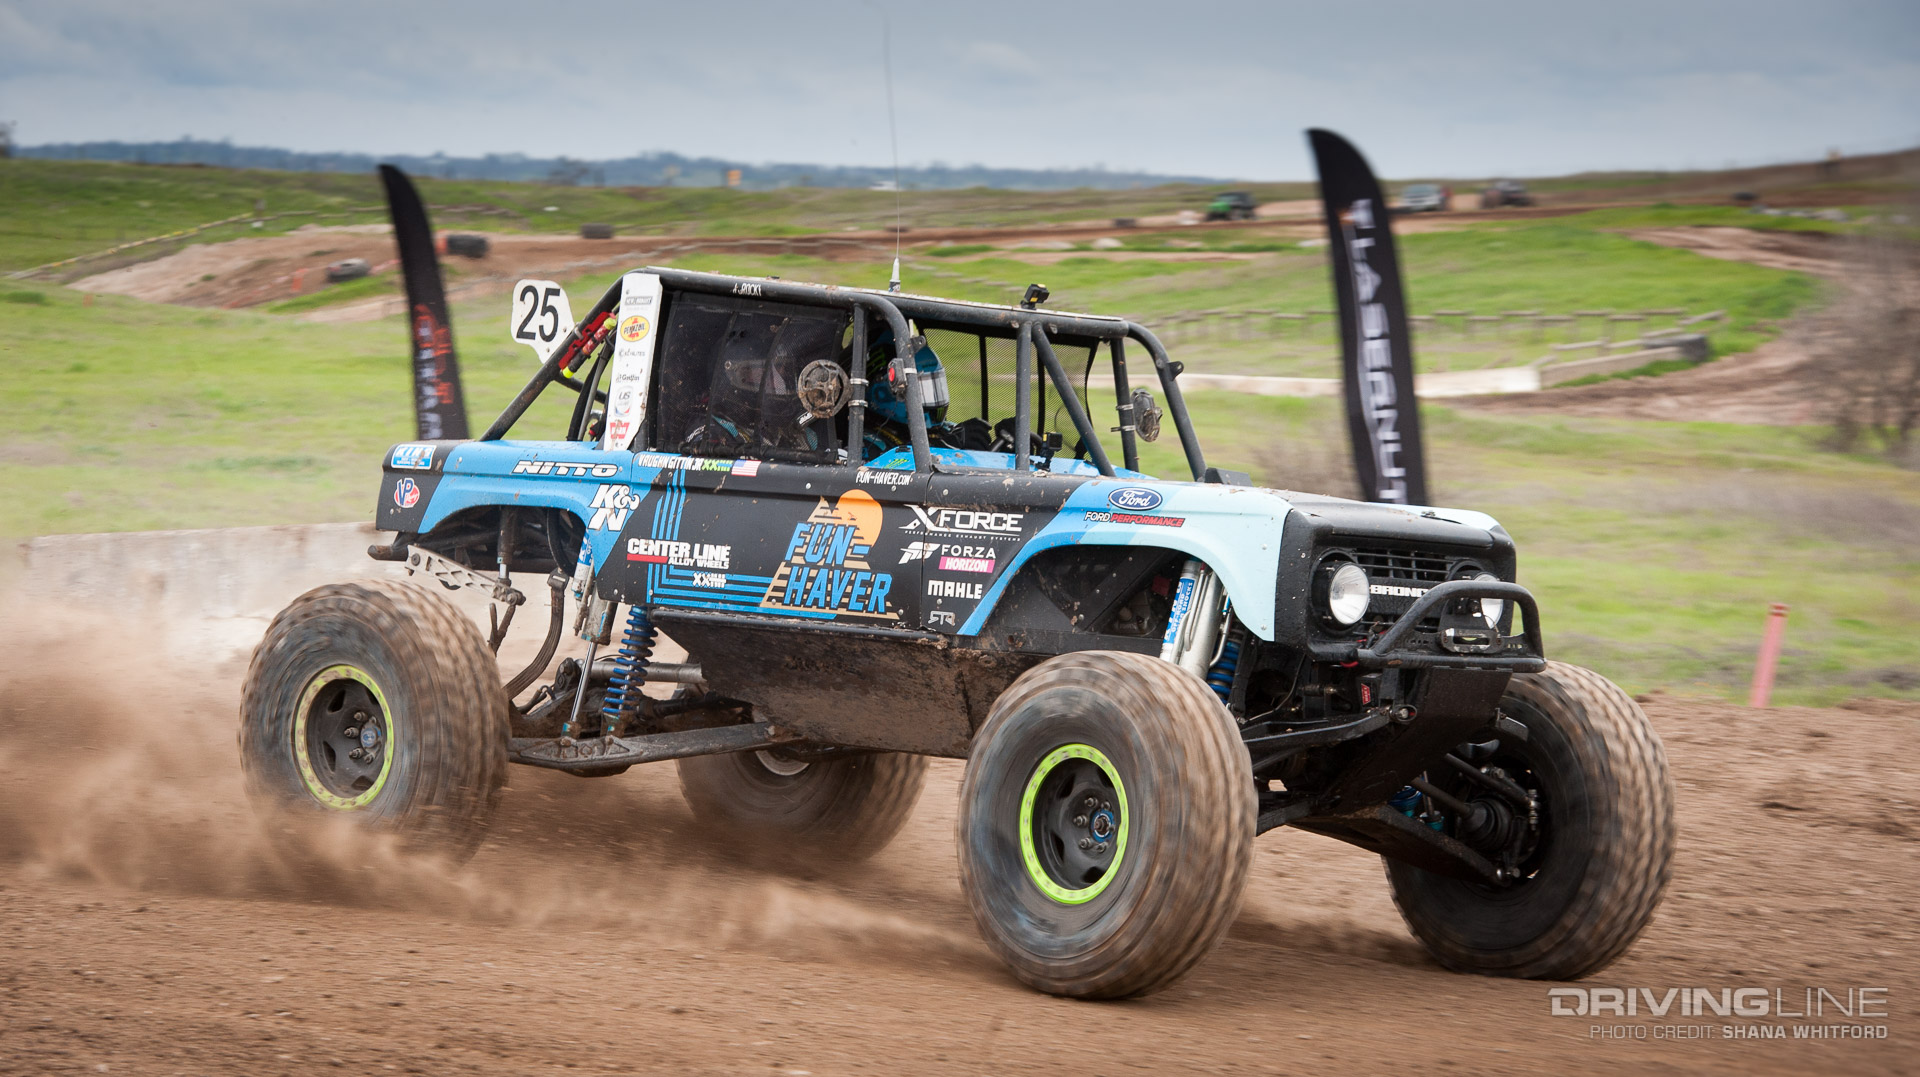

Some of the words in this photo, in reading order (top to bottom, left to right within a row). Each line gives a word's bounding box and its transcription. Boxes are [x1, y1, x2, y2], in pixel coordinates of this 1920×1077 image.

[516, 285, 560, 343] 25
[511, 460, 619, 478] NITTO
[638, 453, 668, 468] VAUGHN
[667, 456, 694, 470] GITTIN
[691, 457, 704, 471] JR
[855, 470, 912, 486] FUN-HAVER.COM
[397, 478, 415, 507] VP
[1118, 489, 1153, 507] Ford
[898, 504, 1024, 532] XFORCE
[1084, 511, 1110, 522] FORD
[1110, 513, 1186, 527] PERFORMANCE
[904, 530, 952, 538] PERFORMANCE
[627, 538, 691, 558] CENTER
[693, 543, 732, 562] LINE
[784, 522, 871, 565] FUN-
[941, 544, 996, 559] FORZA
[667, 556, 696, 567] ALLOY
[696, 559, 730, 570] WHEELS
[944, 557, 989, 572] HORIZON
[783, 565, 893, 613] HAVER
[927, 579, 983, 600] MAHLE
[1370, 584, 1430, 598] BRONC
